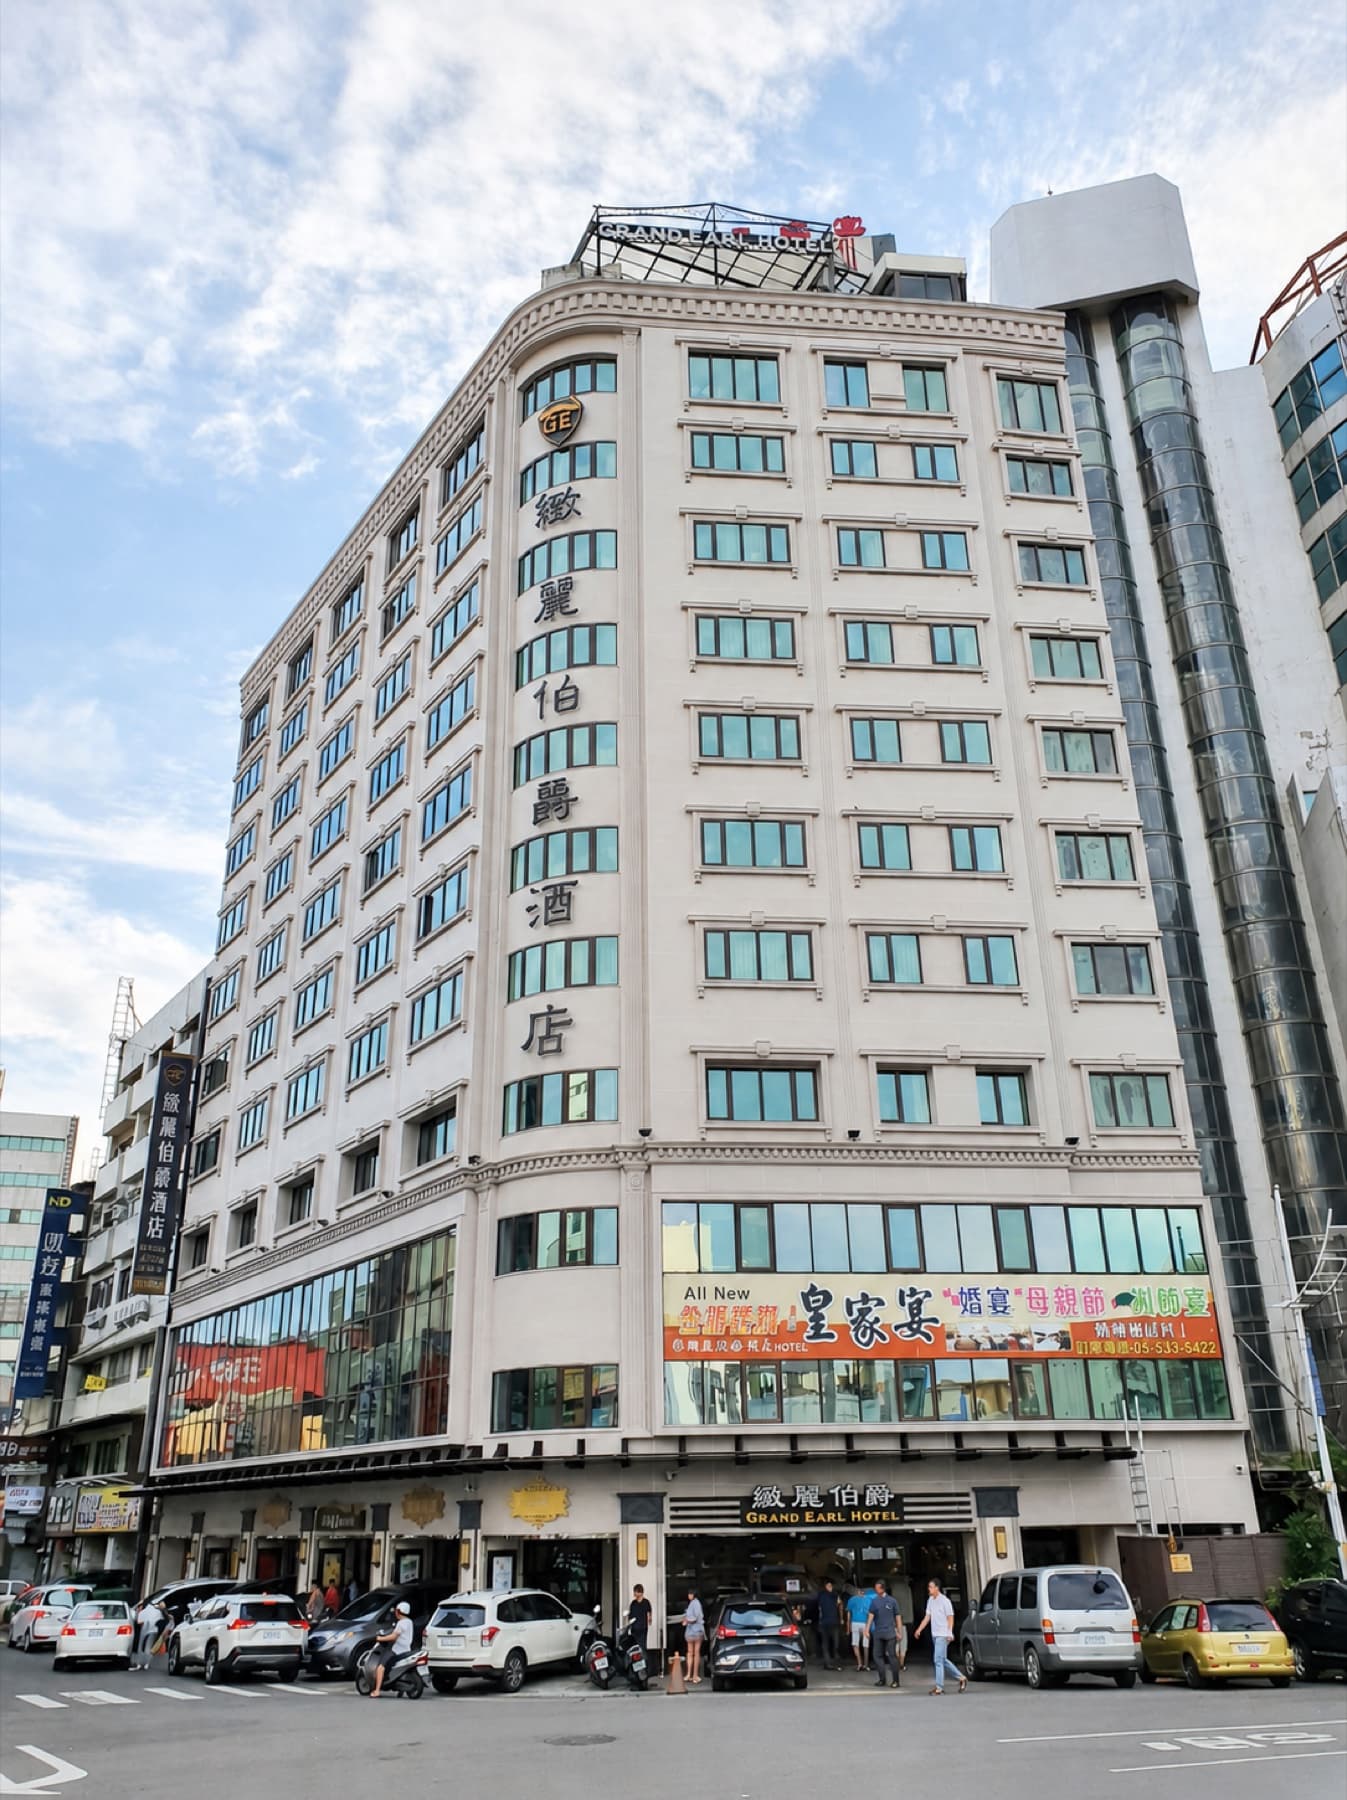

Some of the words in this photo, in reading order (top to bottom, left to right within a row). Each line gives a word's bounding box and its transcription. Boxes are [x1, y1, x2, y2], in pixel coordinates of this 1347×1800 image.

[599, 223, 683, 243] GRAND
[689, 230, 750, 247] EARL
[759, 236, 834, 252] HOTEL
[543, 411, 572, 433] GE
[684, 1286, 706, 1300] All
[714, 1287, 750, 1300] New
[958, 1286, 1012, 1316] 婚宴
[1026, 1286, 1105, 1316] 母親節
[799, 1282, 941, 1348] 皇家宴
[774, 1342, 809, 1353] HOTEL
[745, 1511, 800, 1524] GRAND
[804, 1511, 847, 1523] EARL
[851, 1510, 900, 1522] HOTEL
